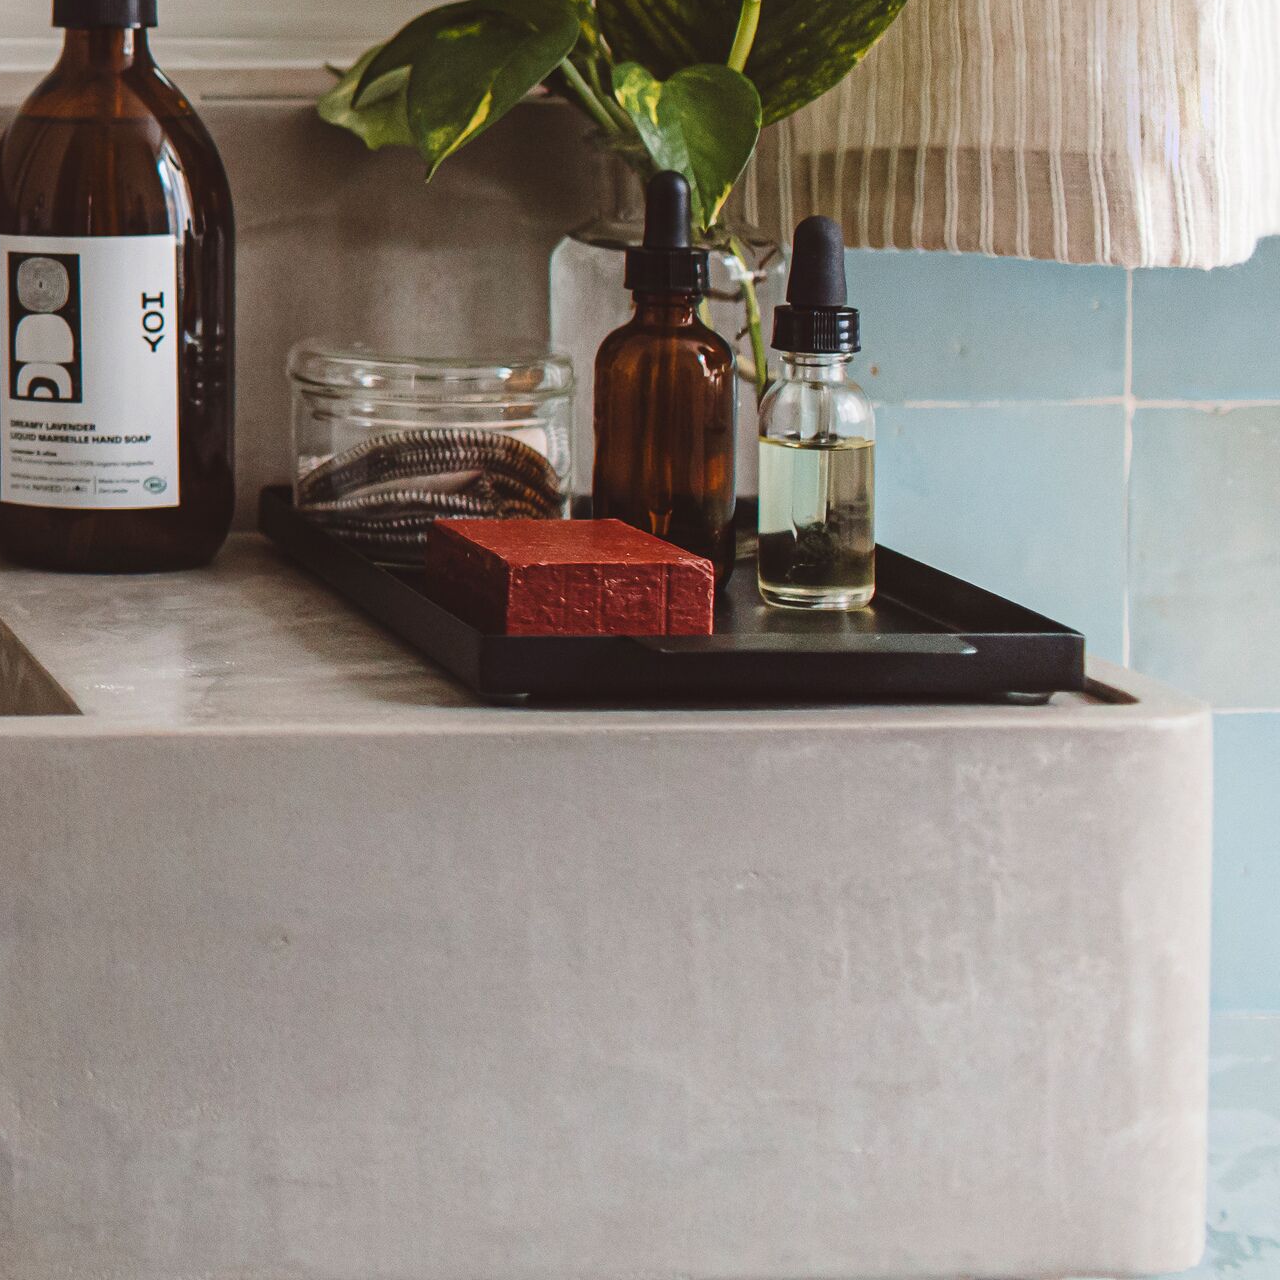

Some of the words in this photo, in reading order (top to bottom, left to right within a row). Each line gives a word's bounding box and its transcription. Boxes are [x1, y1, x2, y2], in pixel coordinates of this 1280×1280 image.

[141, 291, 165, 353] HOY
[46, 422, 96, 432] LAVENDER
[38, 434, 89, 444] MARSEILLE
[92, 435, 122, 444] HAND
[124, 435, 152, 444] SOAP
